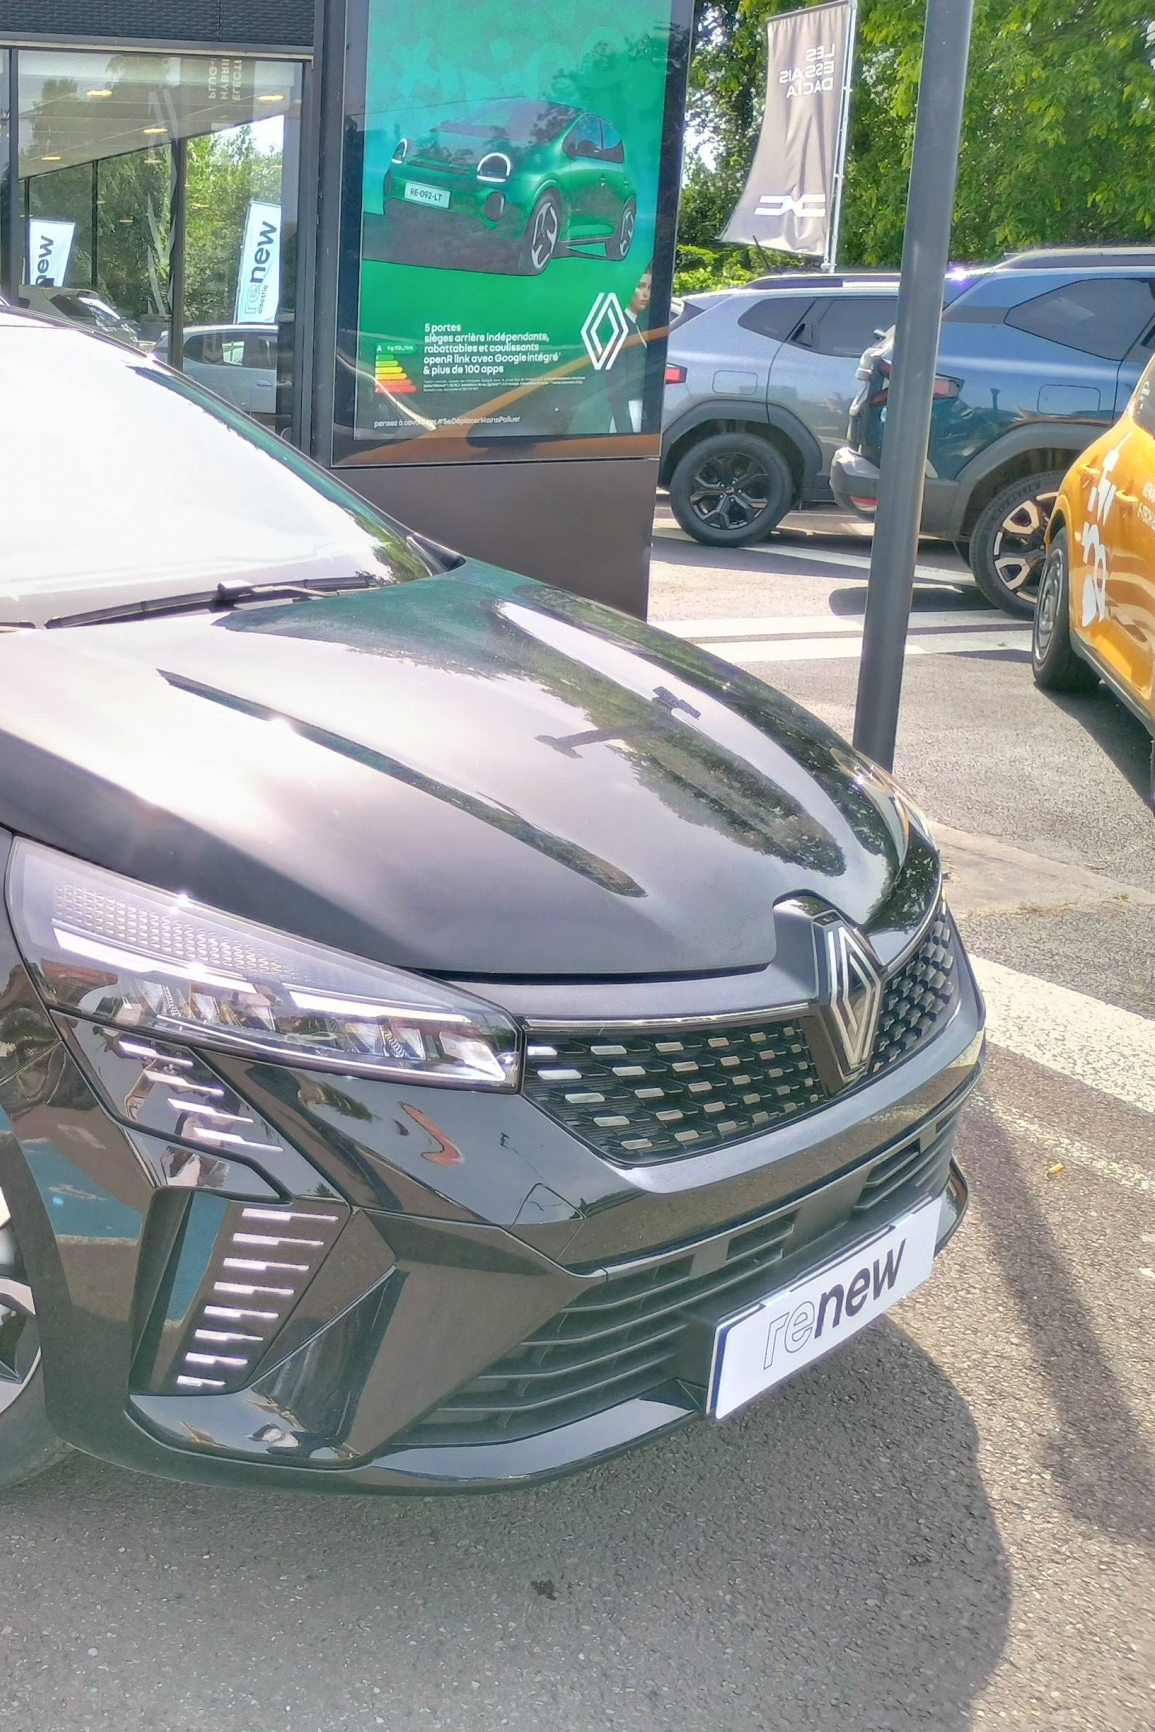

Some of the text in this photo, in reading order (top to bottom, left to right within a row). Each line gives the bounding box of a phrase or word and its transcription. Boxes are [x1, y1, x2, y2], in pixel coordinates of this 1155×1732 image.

[246, 221, 277, 315] renew
[424, 323, 462, 337] 5 portes
[424, 332, 549, 345] sièges arrière indépendants,
[424, 342, 539, 354] rabattables et coulissants
[423, 355, 453, 366] openR
[454, 354, 470, 363] link
[494, 353, 527, 365] Google
[423, 365, 504, 377] & plus de 100 apps
[763, 1238, 907, 1370] renew
